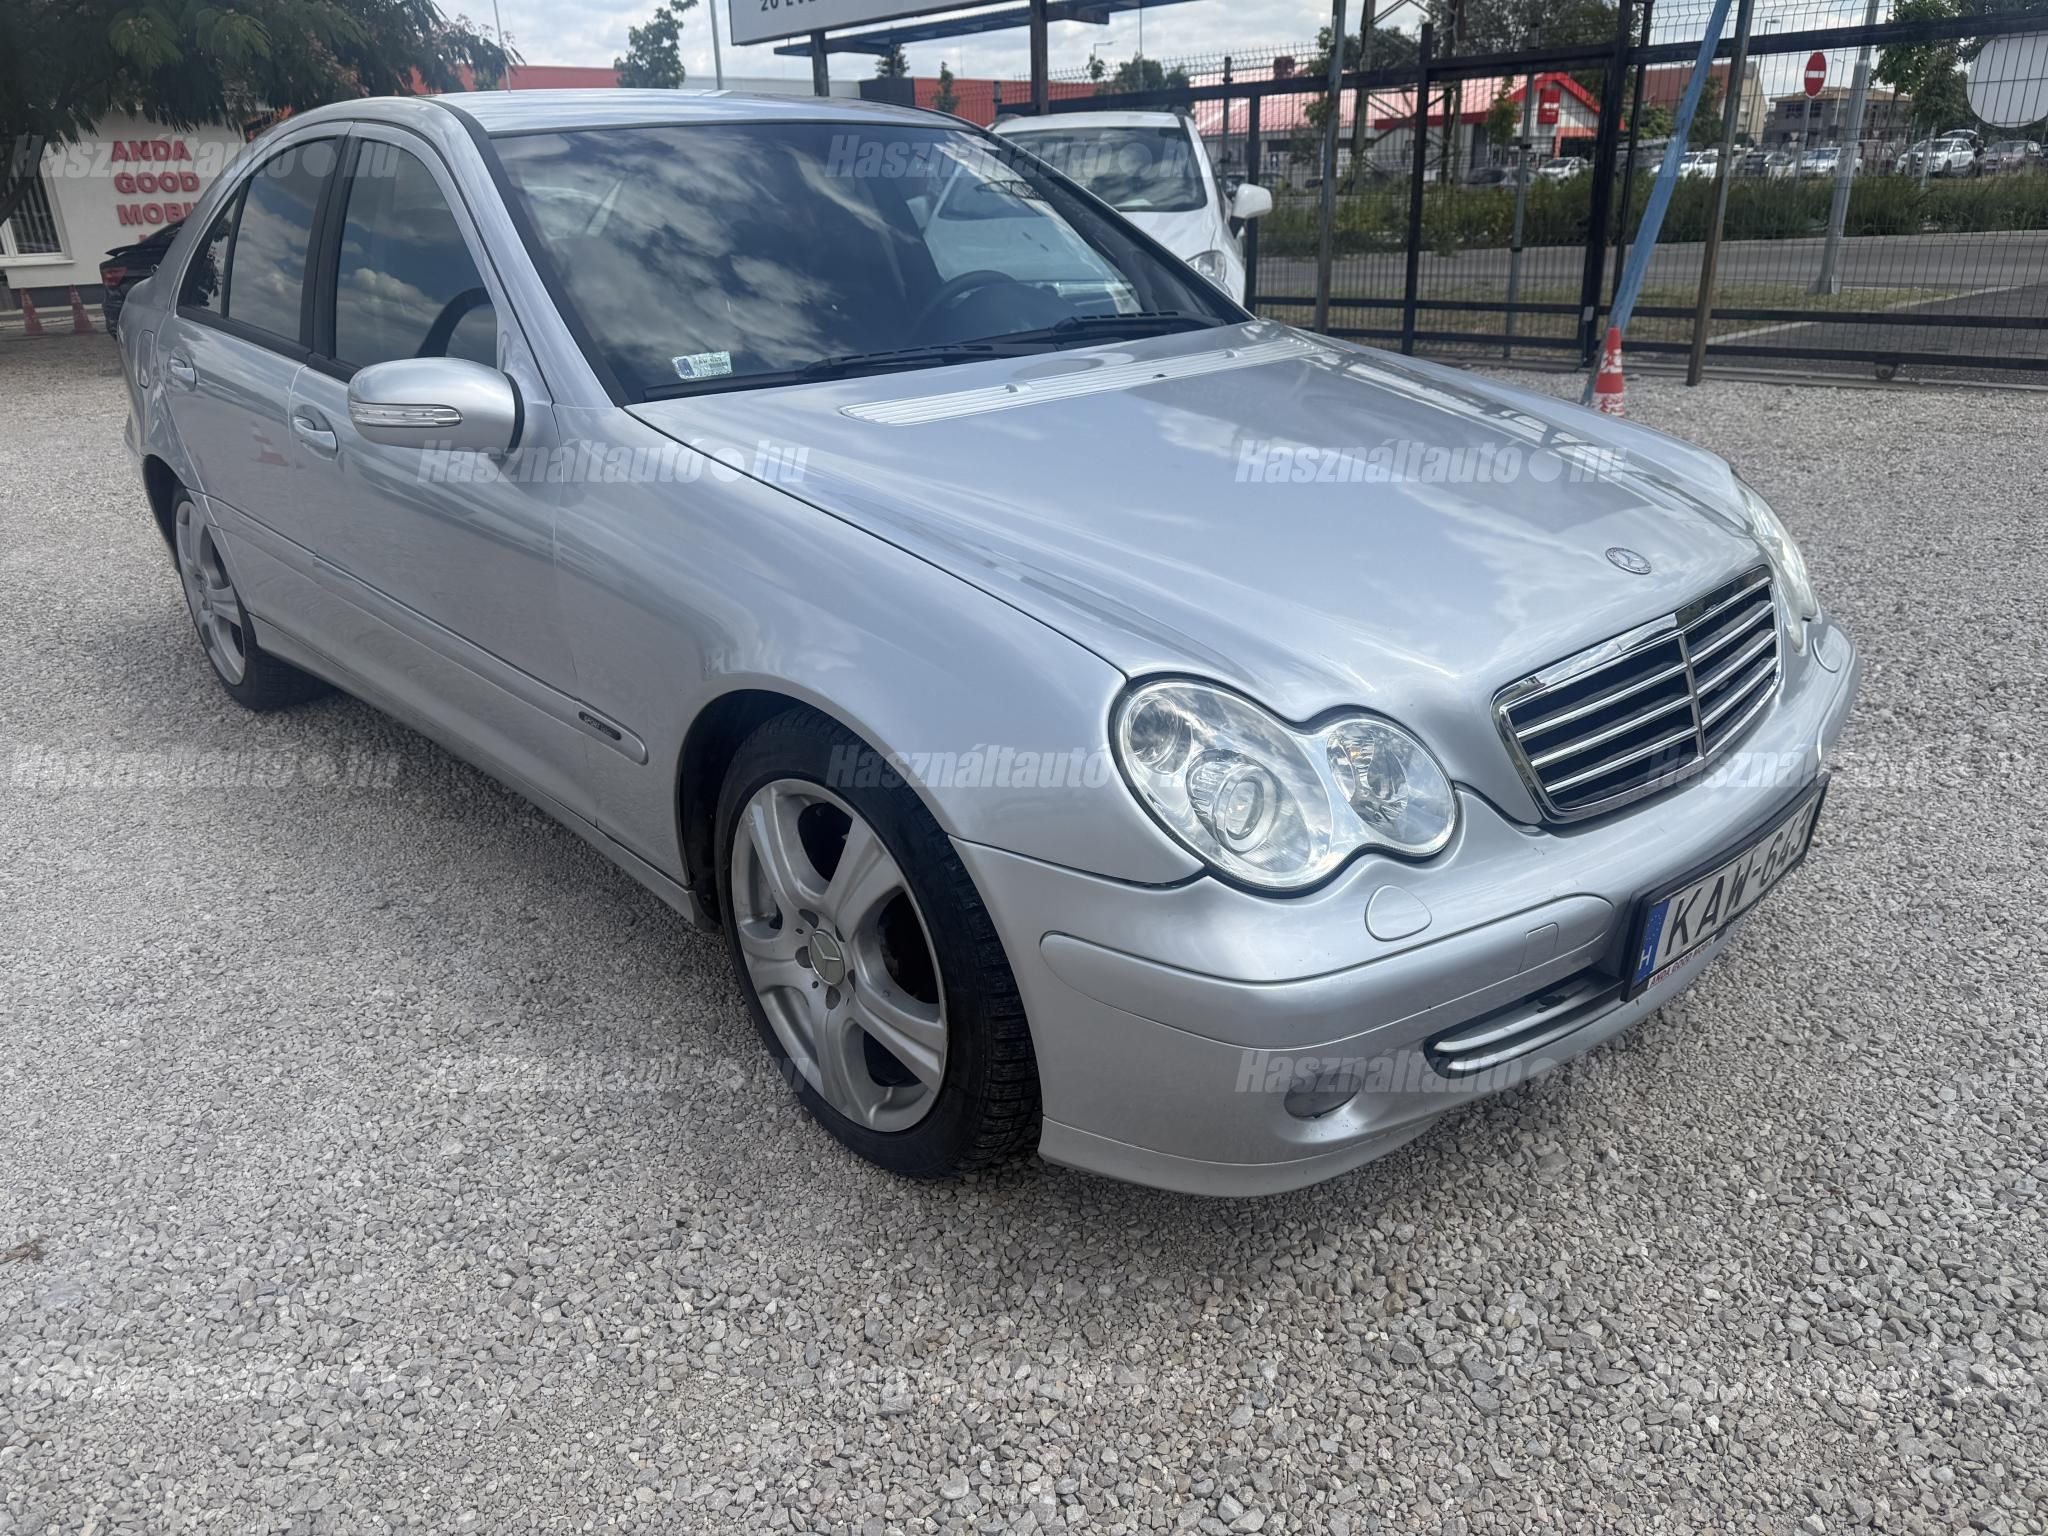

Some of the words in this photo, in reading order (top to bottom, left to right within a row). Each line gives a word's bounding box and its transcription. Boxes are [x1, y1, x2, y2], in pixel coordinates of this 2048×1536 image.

[112, 140, 192, 162] ANDA
[114, 172, 200, 194] GOOD
[116, 202, 197, 225] MOBI
[1664, 802, 1813, 957] KAW-643
[1639, 944, 1653, 970] H
